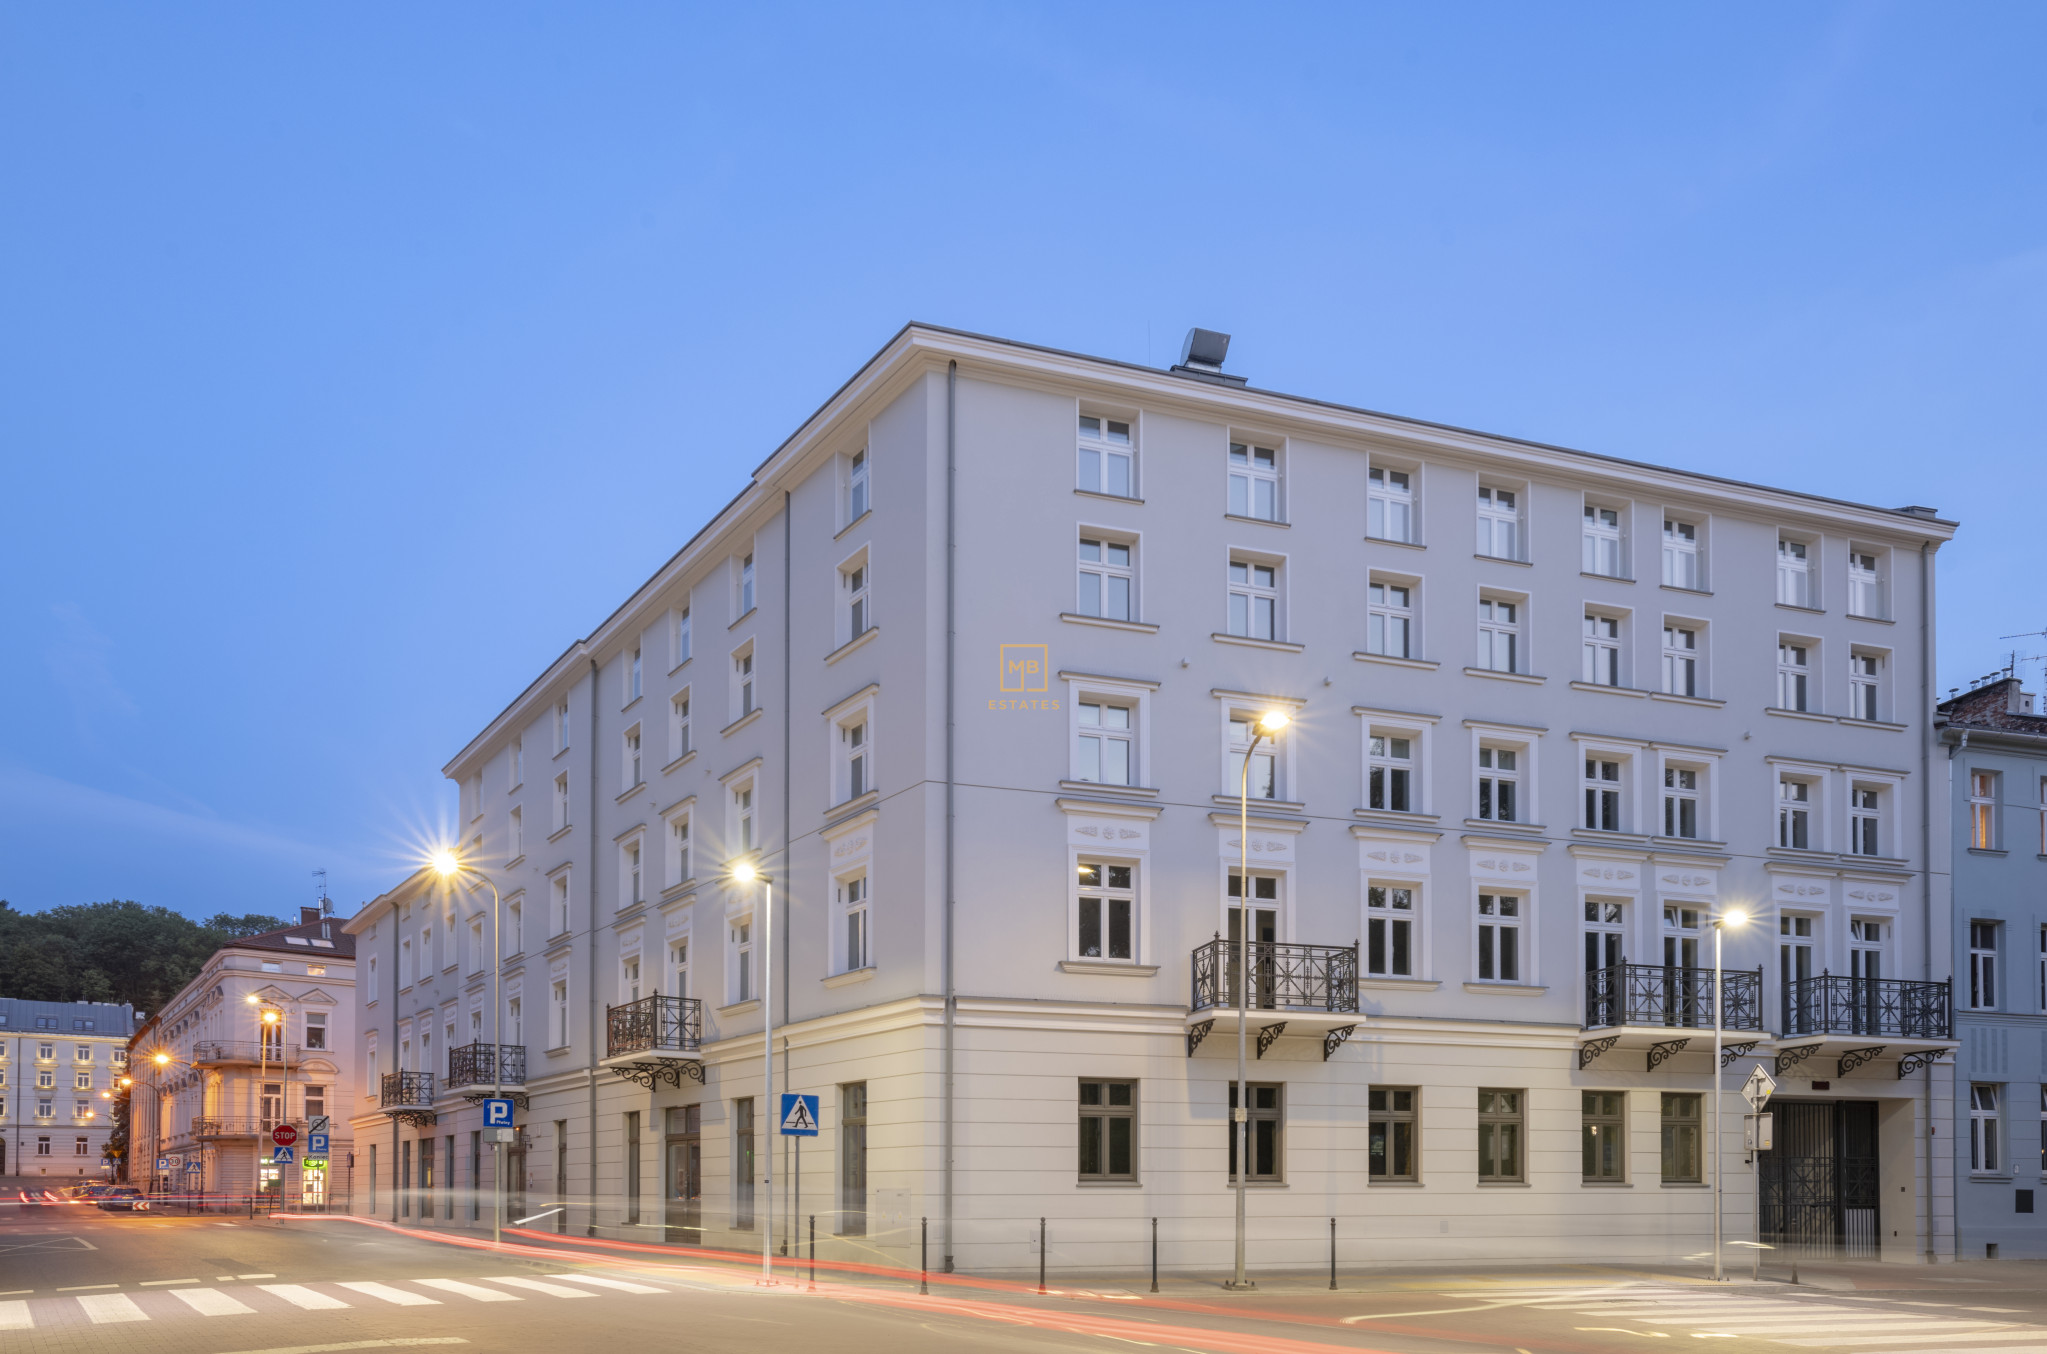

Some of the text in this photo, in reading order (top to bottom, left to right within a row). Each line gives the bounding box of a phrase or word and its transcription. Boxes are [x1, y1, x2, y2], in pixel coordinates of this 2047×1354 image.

[490, 1102, 508, 1124] P
[312, 1136, 324, 1150] P
[159, 1159, 167, 1168] P
